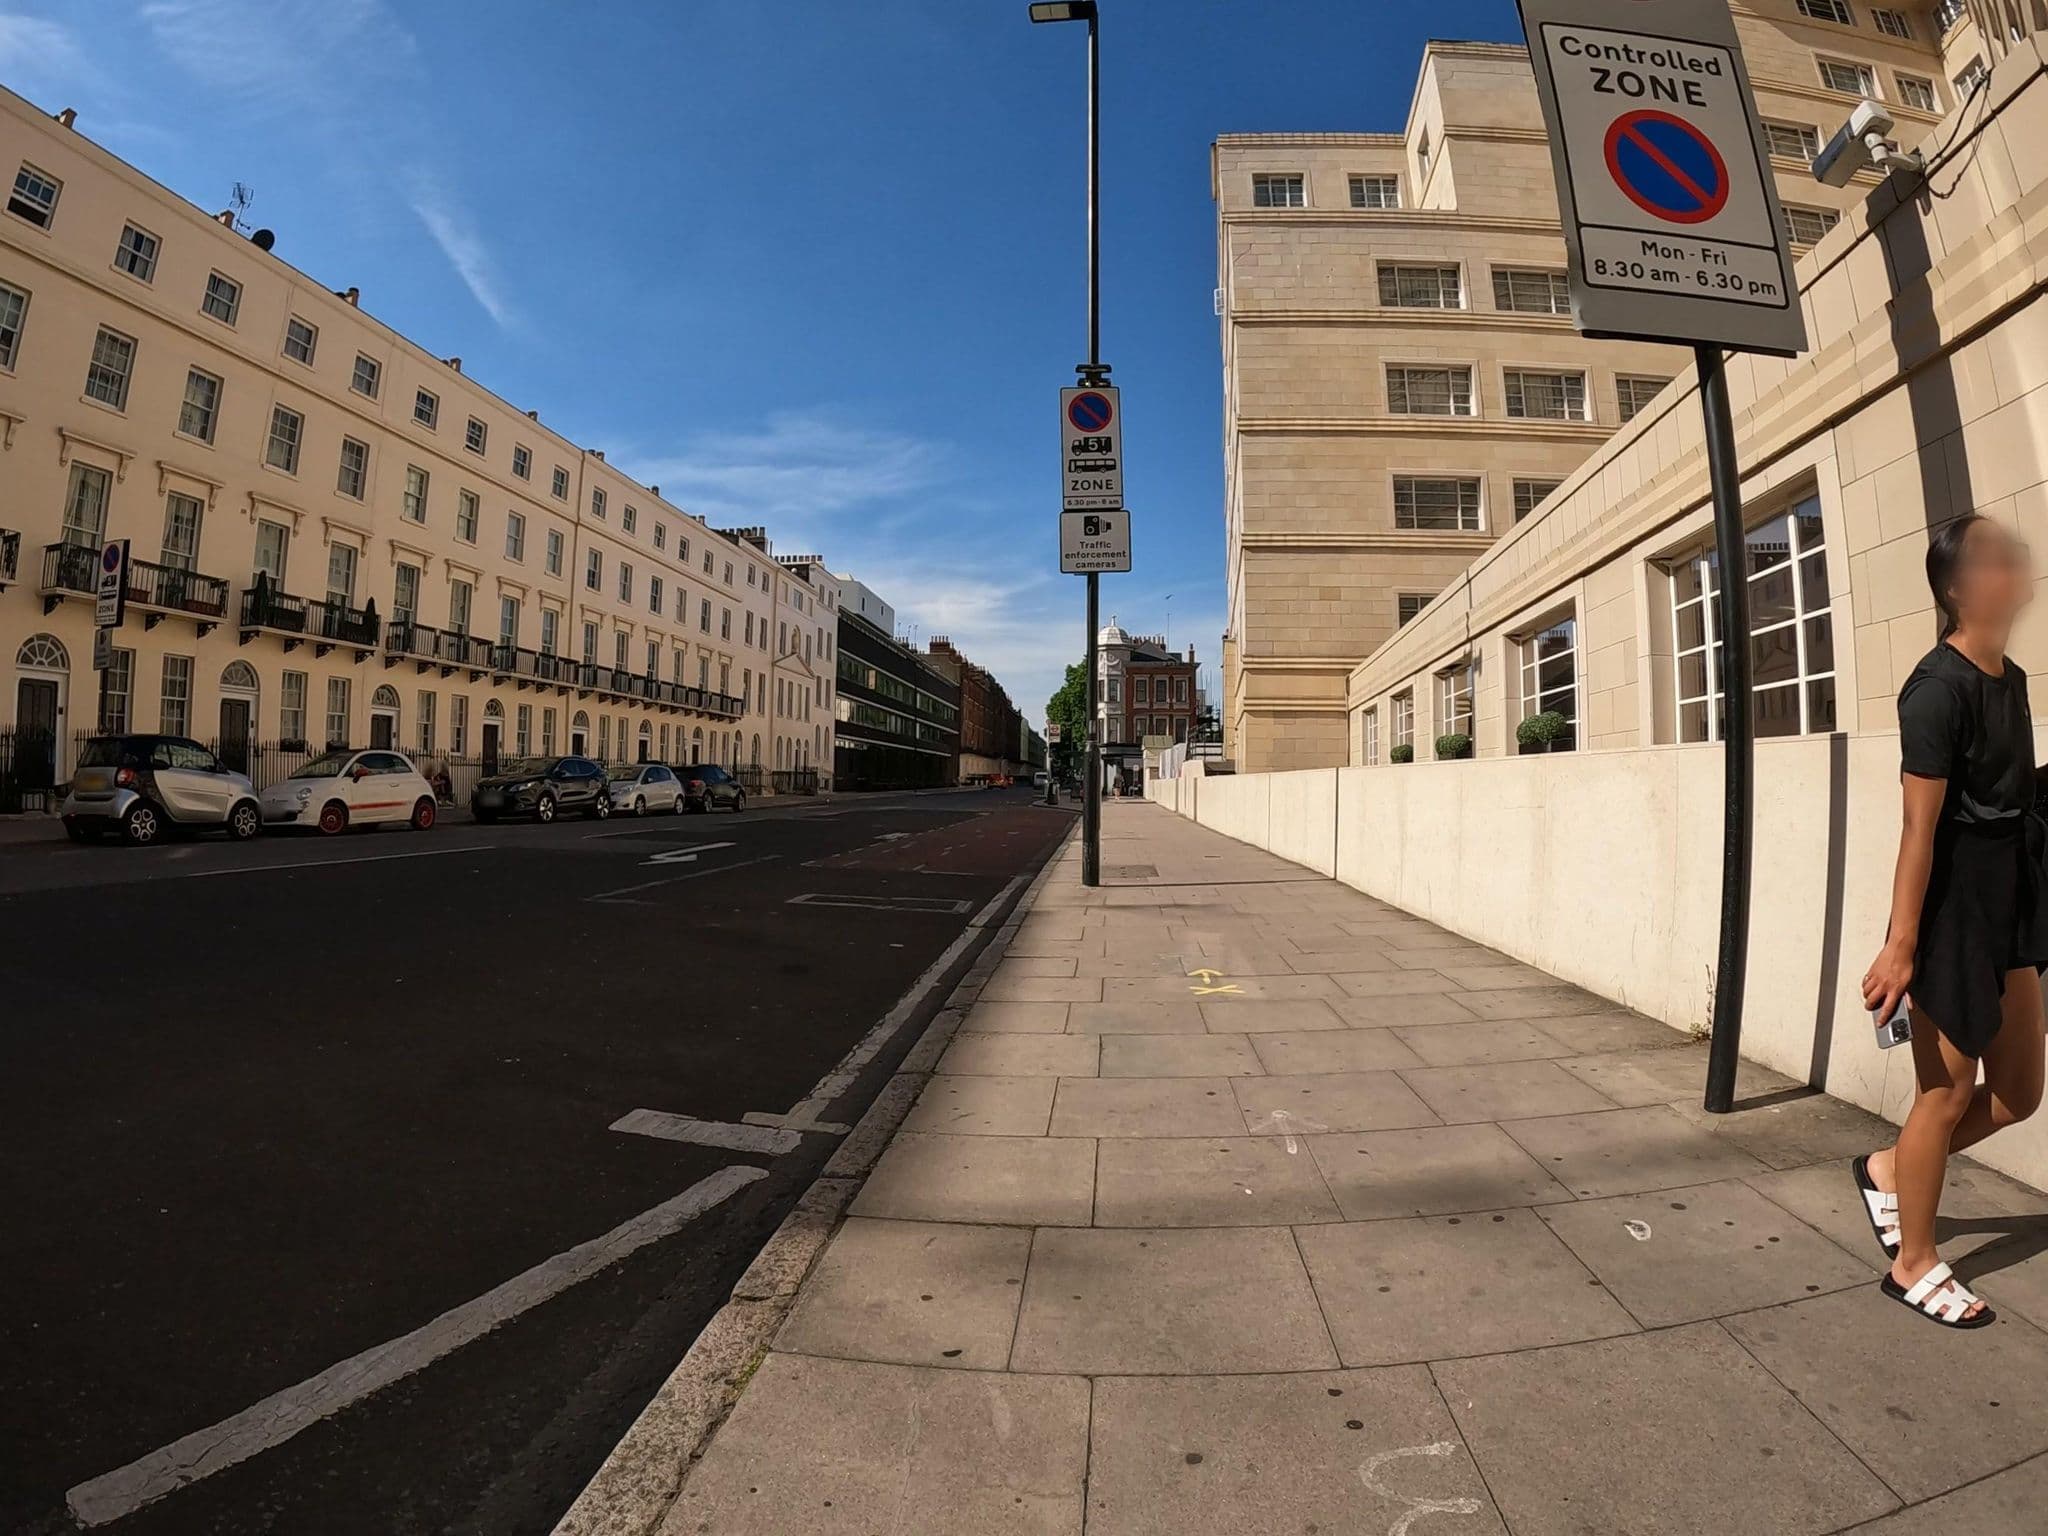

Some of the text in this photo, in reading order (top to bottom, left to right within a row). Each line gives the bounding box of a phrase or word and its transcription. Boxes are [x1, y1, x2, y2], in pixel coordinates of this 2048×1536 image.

[1559, 36, 1722, 77] Controlled
[1589, 66, 1707, 107] ZONE
[1640, 240, 1685, 260] Mon
[1701, 248, 1727, 266] Fri
[1594, 258, 1644, 279] 8.30
[1650, 268, 1680, 283] am
[1696, 270, 1743, 291] 6.30
[1748, 280, 1777, 296] pm
[1071, 479, 1114, 491] ZONE
[1079, 541, 1112, 549] Traffic
[1064, 550, 1127, 560] enforcement
[1075, 561, 1117, 569] cameras
